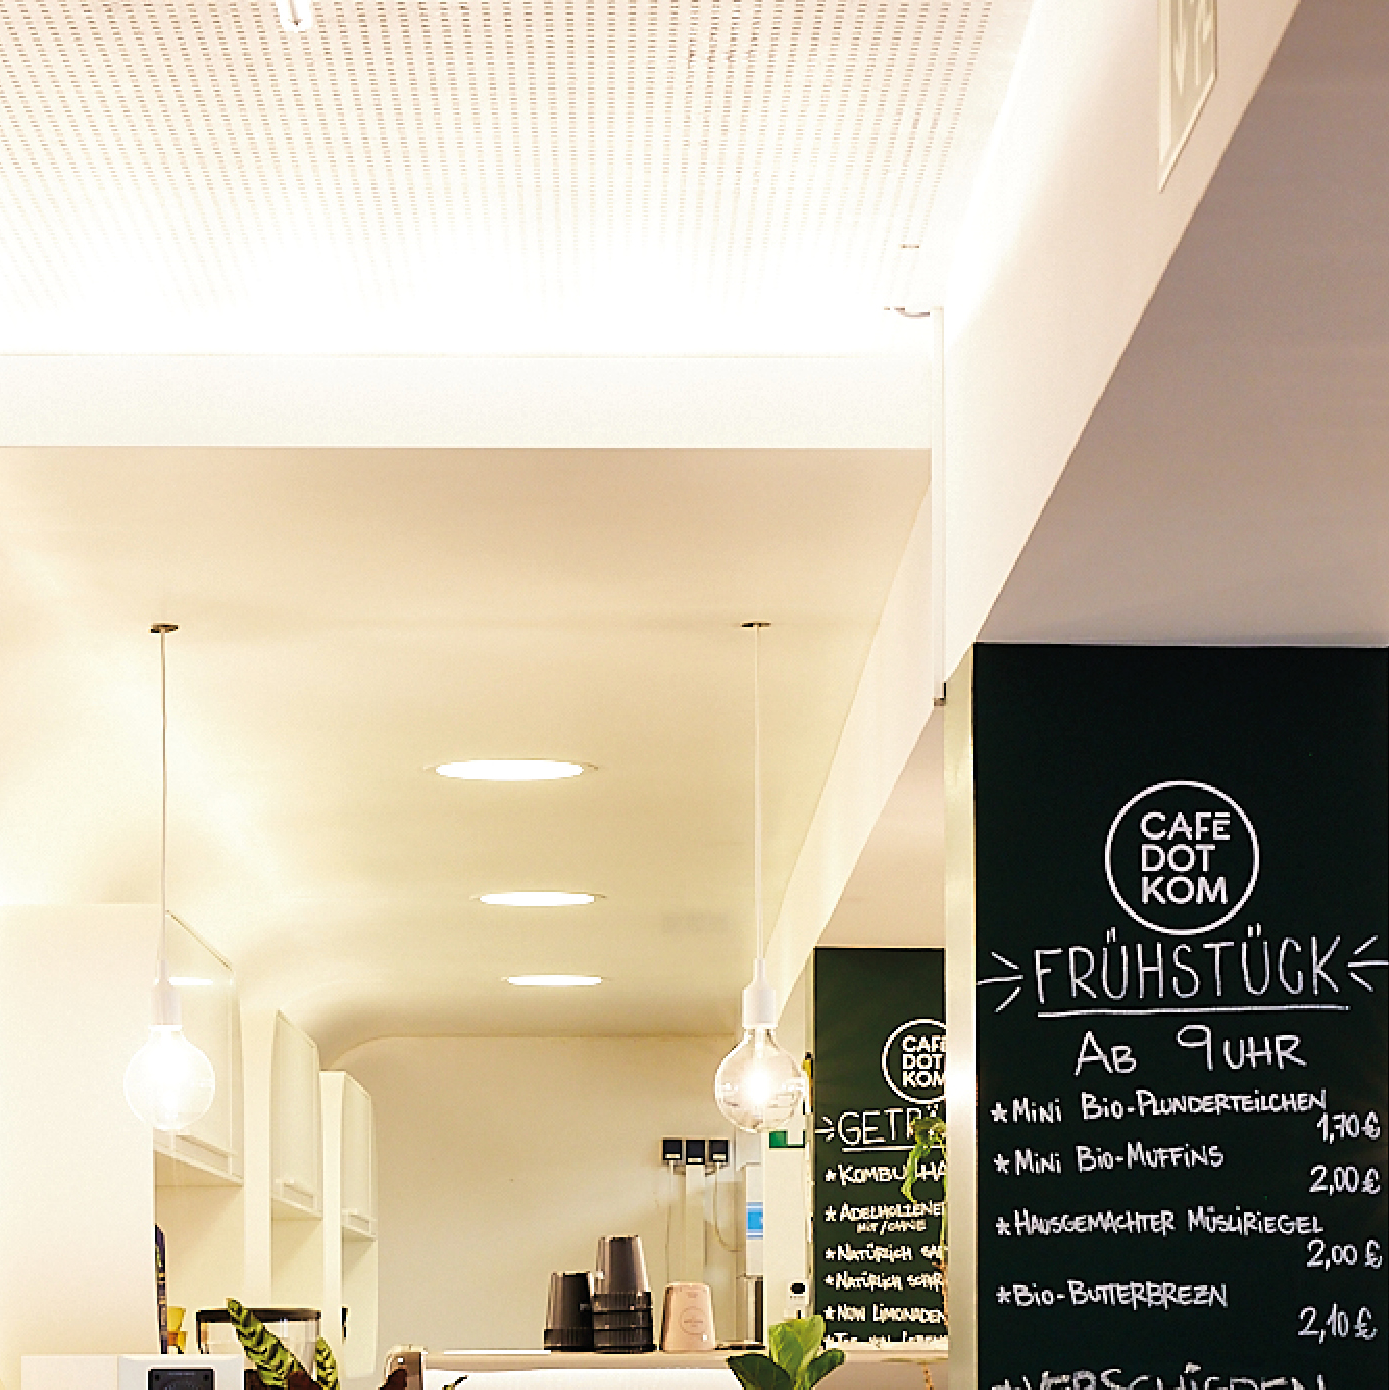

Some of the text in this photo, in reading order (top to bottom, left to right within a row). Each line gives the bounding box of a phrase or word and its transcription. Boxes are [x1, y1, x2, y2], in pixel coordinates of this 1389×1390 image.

[1142, 844, 1215, 871] DOT
[1142, 875, 1228, 904] KOM
[1034, 924, 1341, 1003] FRÜHSTÜCK
